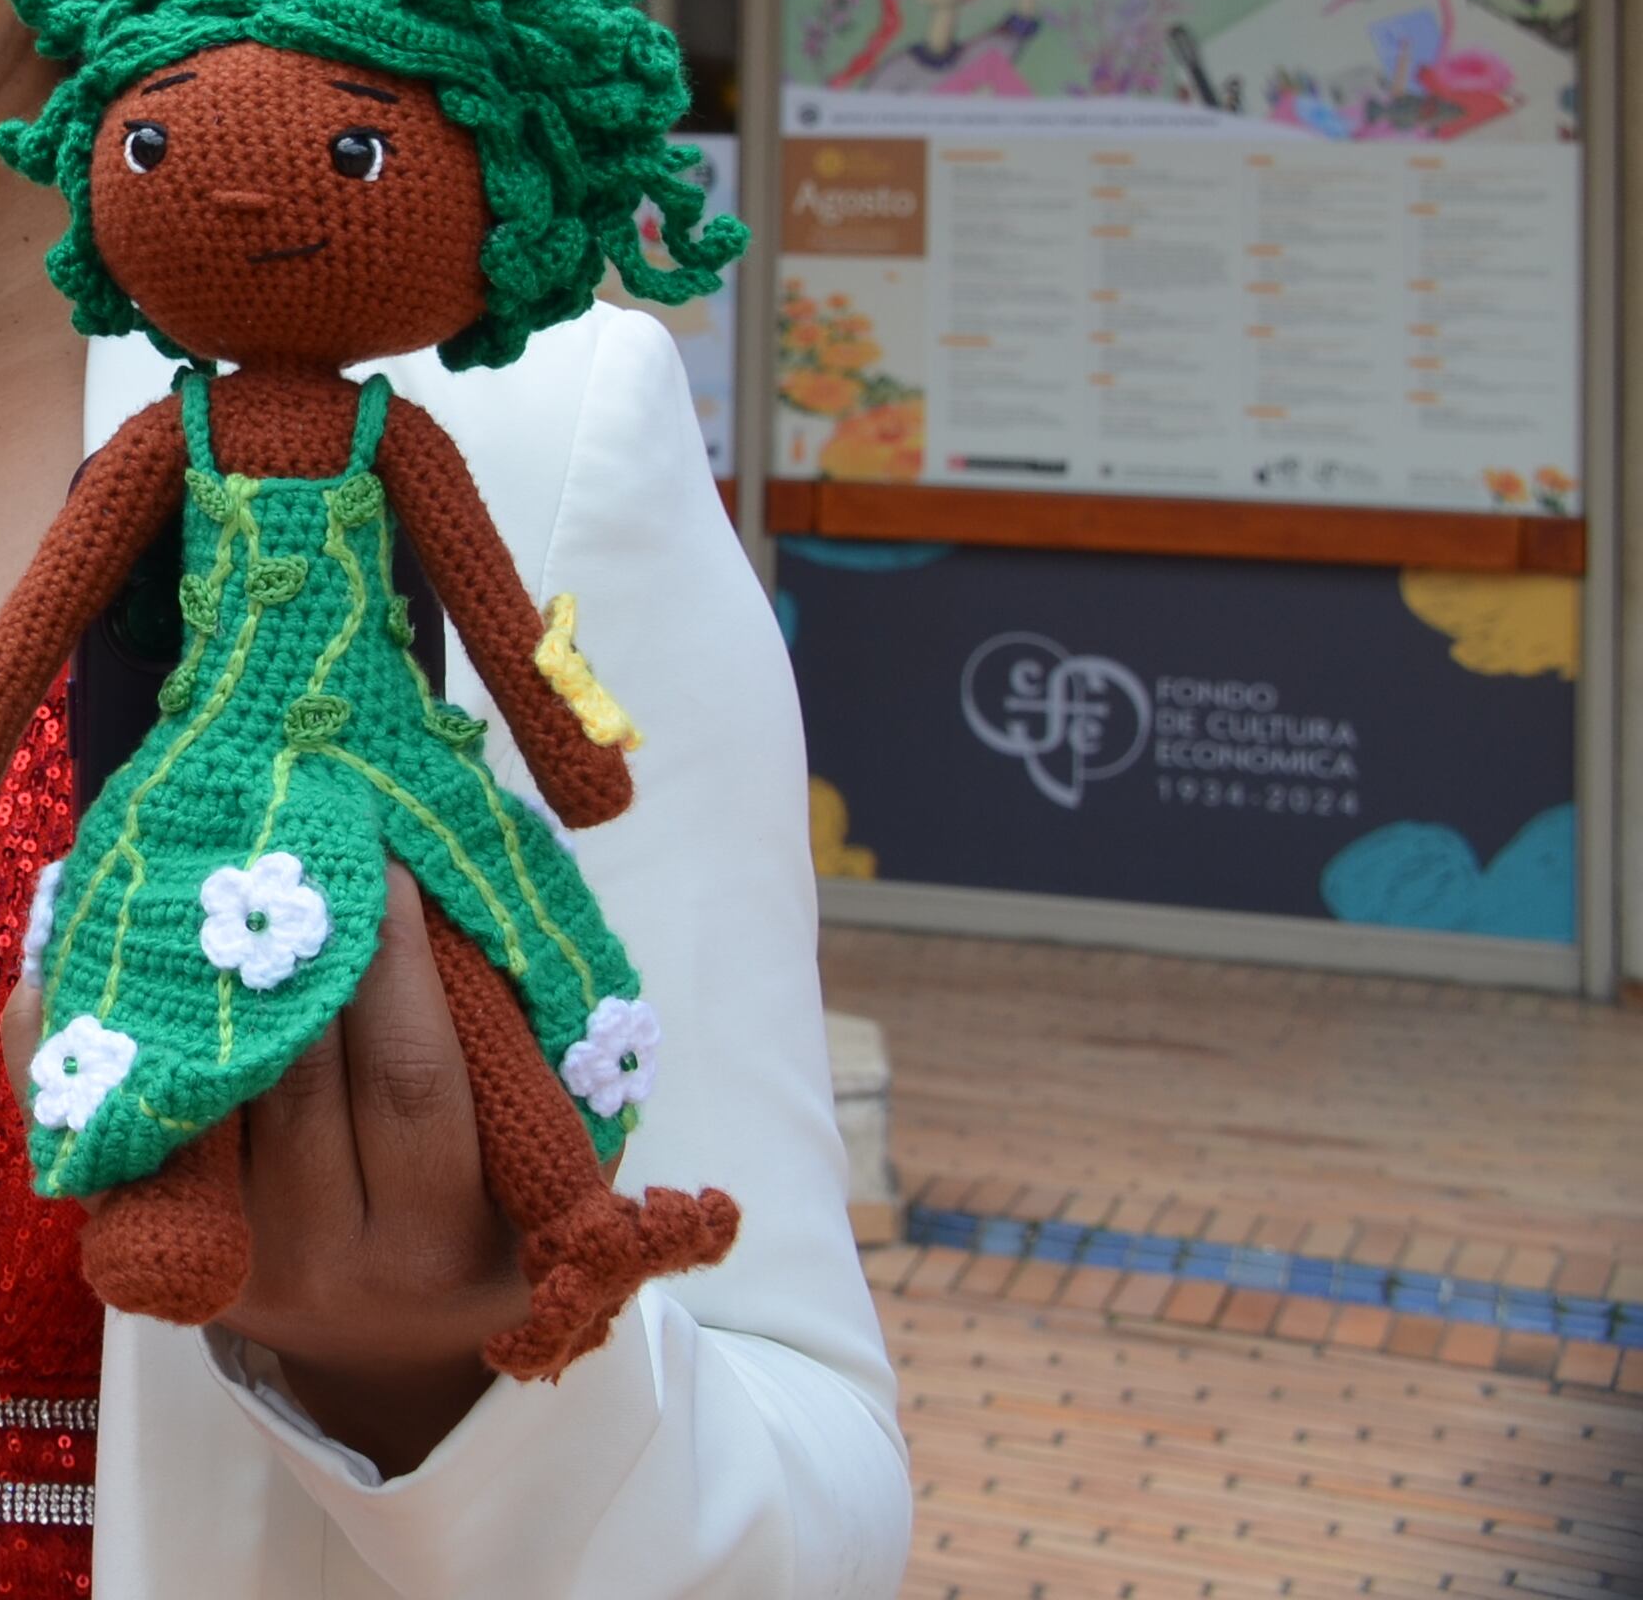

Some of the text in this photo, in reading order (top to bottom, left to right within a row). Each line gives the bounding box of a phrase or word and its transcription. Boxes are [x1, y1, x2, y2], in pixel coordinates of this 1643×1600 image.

[793, 181, 918, 226] Agosto
[1155, 676, 1279, 712] FONDO
[1155, 707, 1359, 748] DE CULTURA
[1157, 774, 1360, 817] 1934-2024
